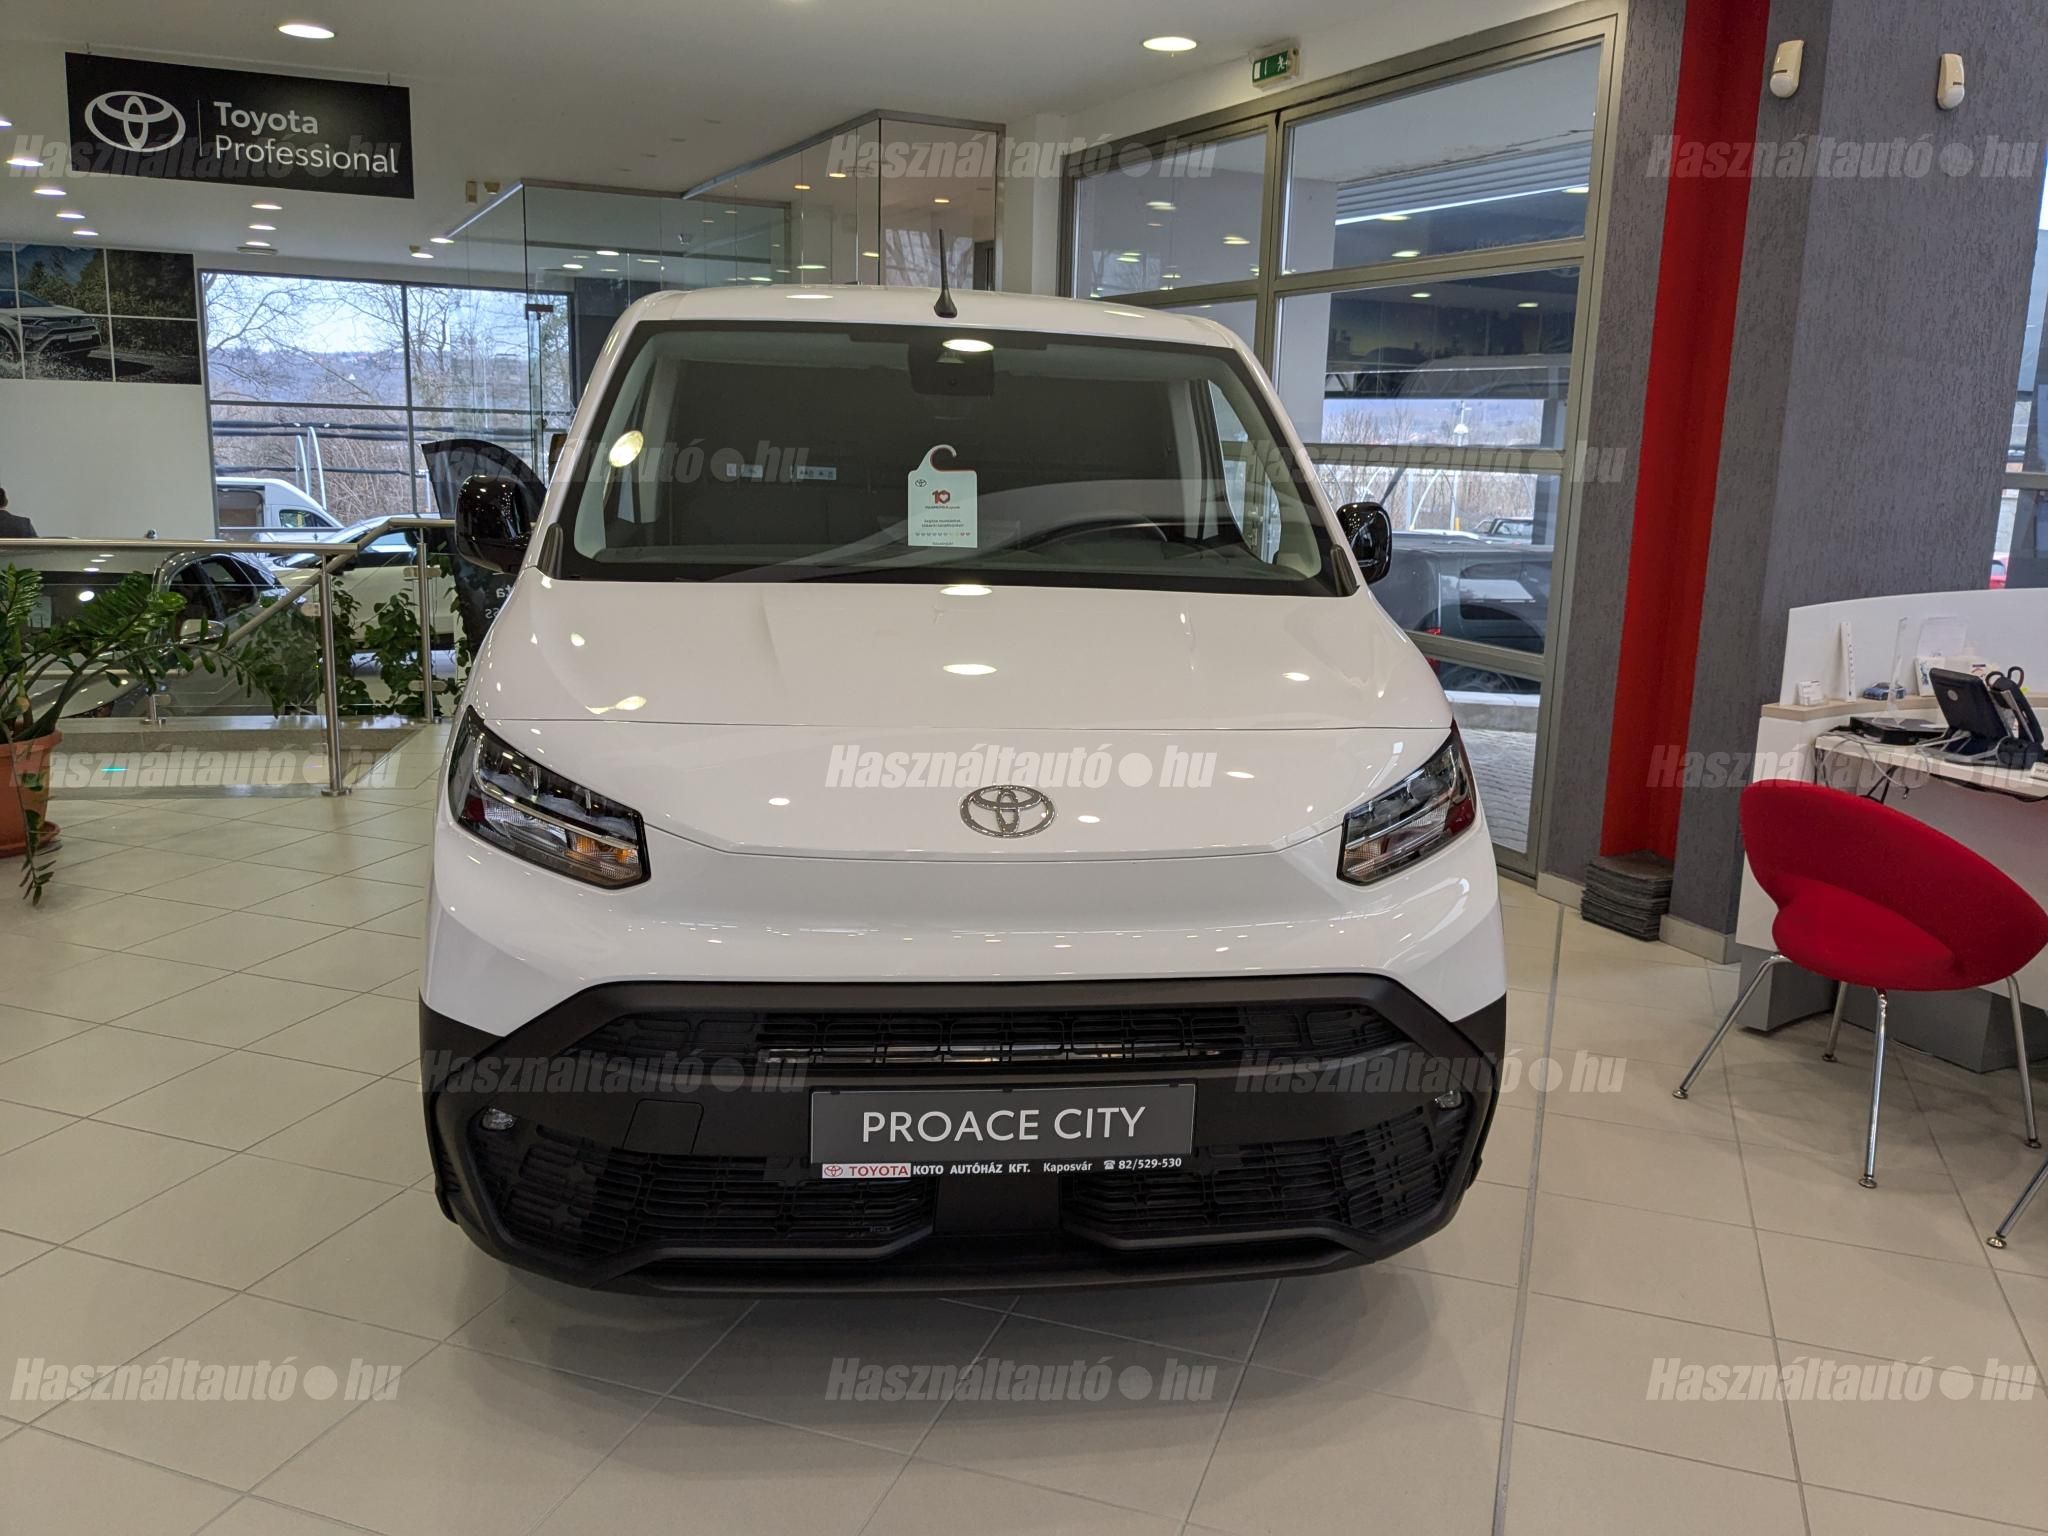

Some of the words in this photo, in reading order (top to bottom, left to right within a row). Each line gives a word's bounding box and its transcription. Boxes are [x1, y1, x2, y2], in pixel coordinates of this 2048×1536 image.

[213, 101, 318, 136] Toyota
[215, 135, 398, 174] Professional
[862, 1109, 1040, 1143] PROACE
[1053, 1106, 1146, 1140] CITY
[848, 1165, 909, 1177] TOYOTA
[913, 1165, 944, 1176] KOTO
[949, 1161, 1003, 1175] AUTÓHÁZ
[1008, 1162, 1031, 1174] KFT.
[1043, 1160, 1093, 1175] Kaposvár
[1118, 1157, 1182, 1172] 82/529-530
